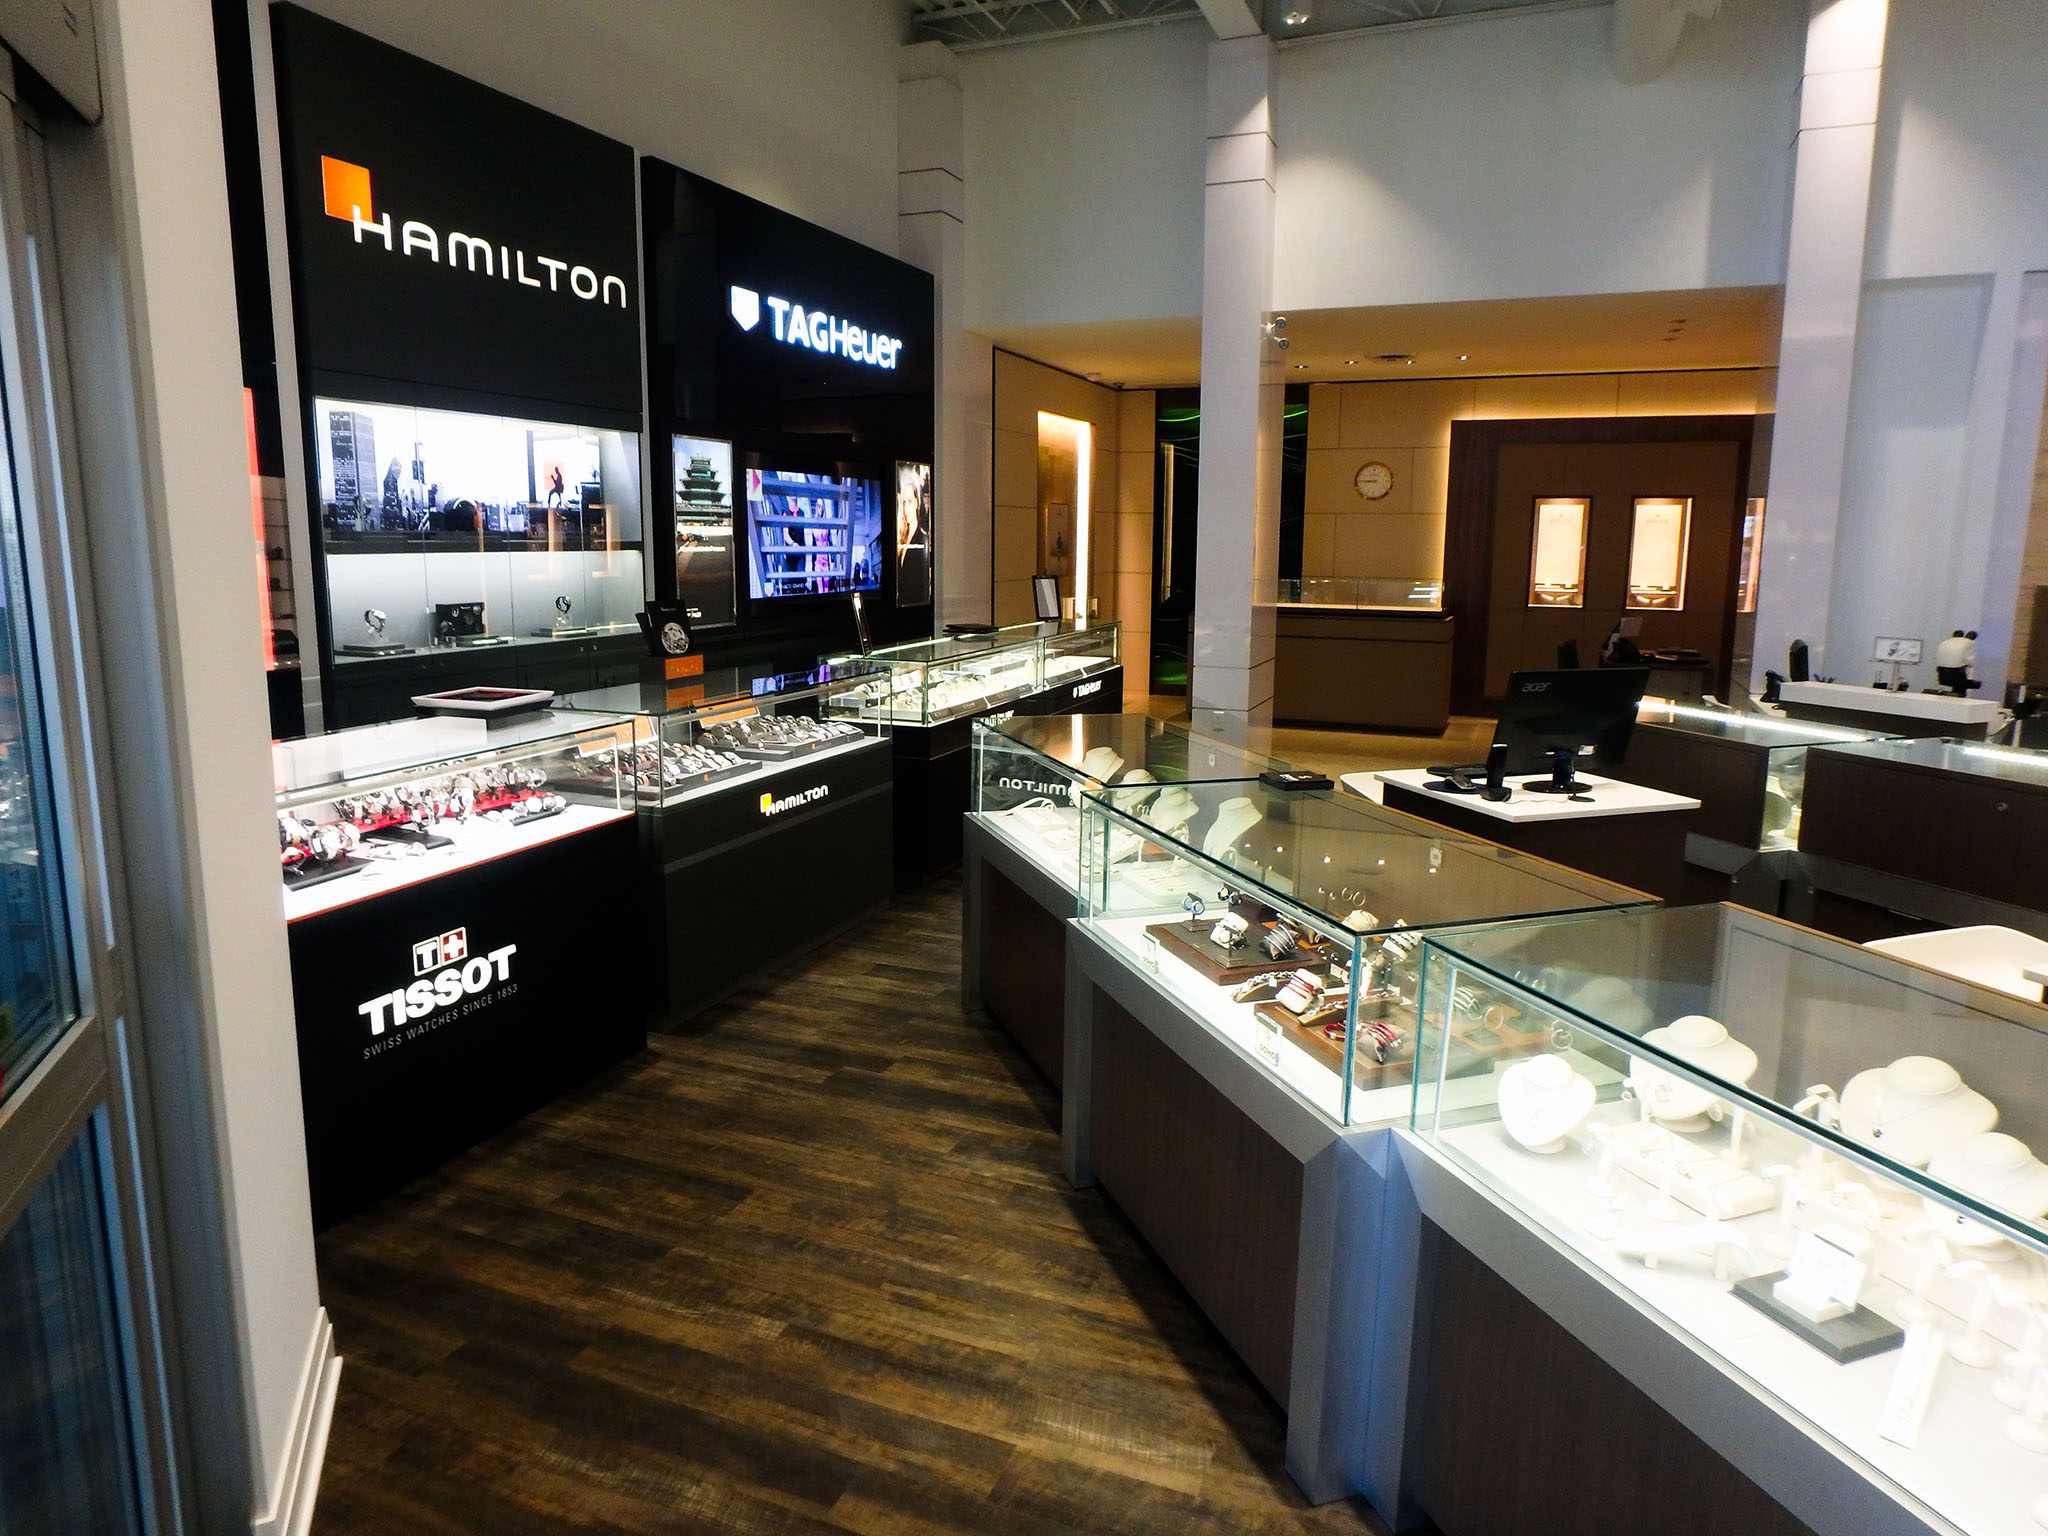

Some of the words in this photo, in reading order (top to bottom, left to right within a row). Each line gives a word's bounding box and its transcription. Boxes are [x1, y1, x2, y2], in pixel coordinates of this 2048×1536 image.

[353, 204, 627, 309] HAMILTON
[1521, 682, 1552, 693] acer
[765, 785, 829, 817] HAMILTON
[358, 943, 517, 1036] TISSOT
[363, 1033, 402, 1060] SWISS
[406, 1009, 458, 1040] WATCHES
[462, 993, 493, 1016] SINCE
[497, 983, 518, 999] 1853
